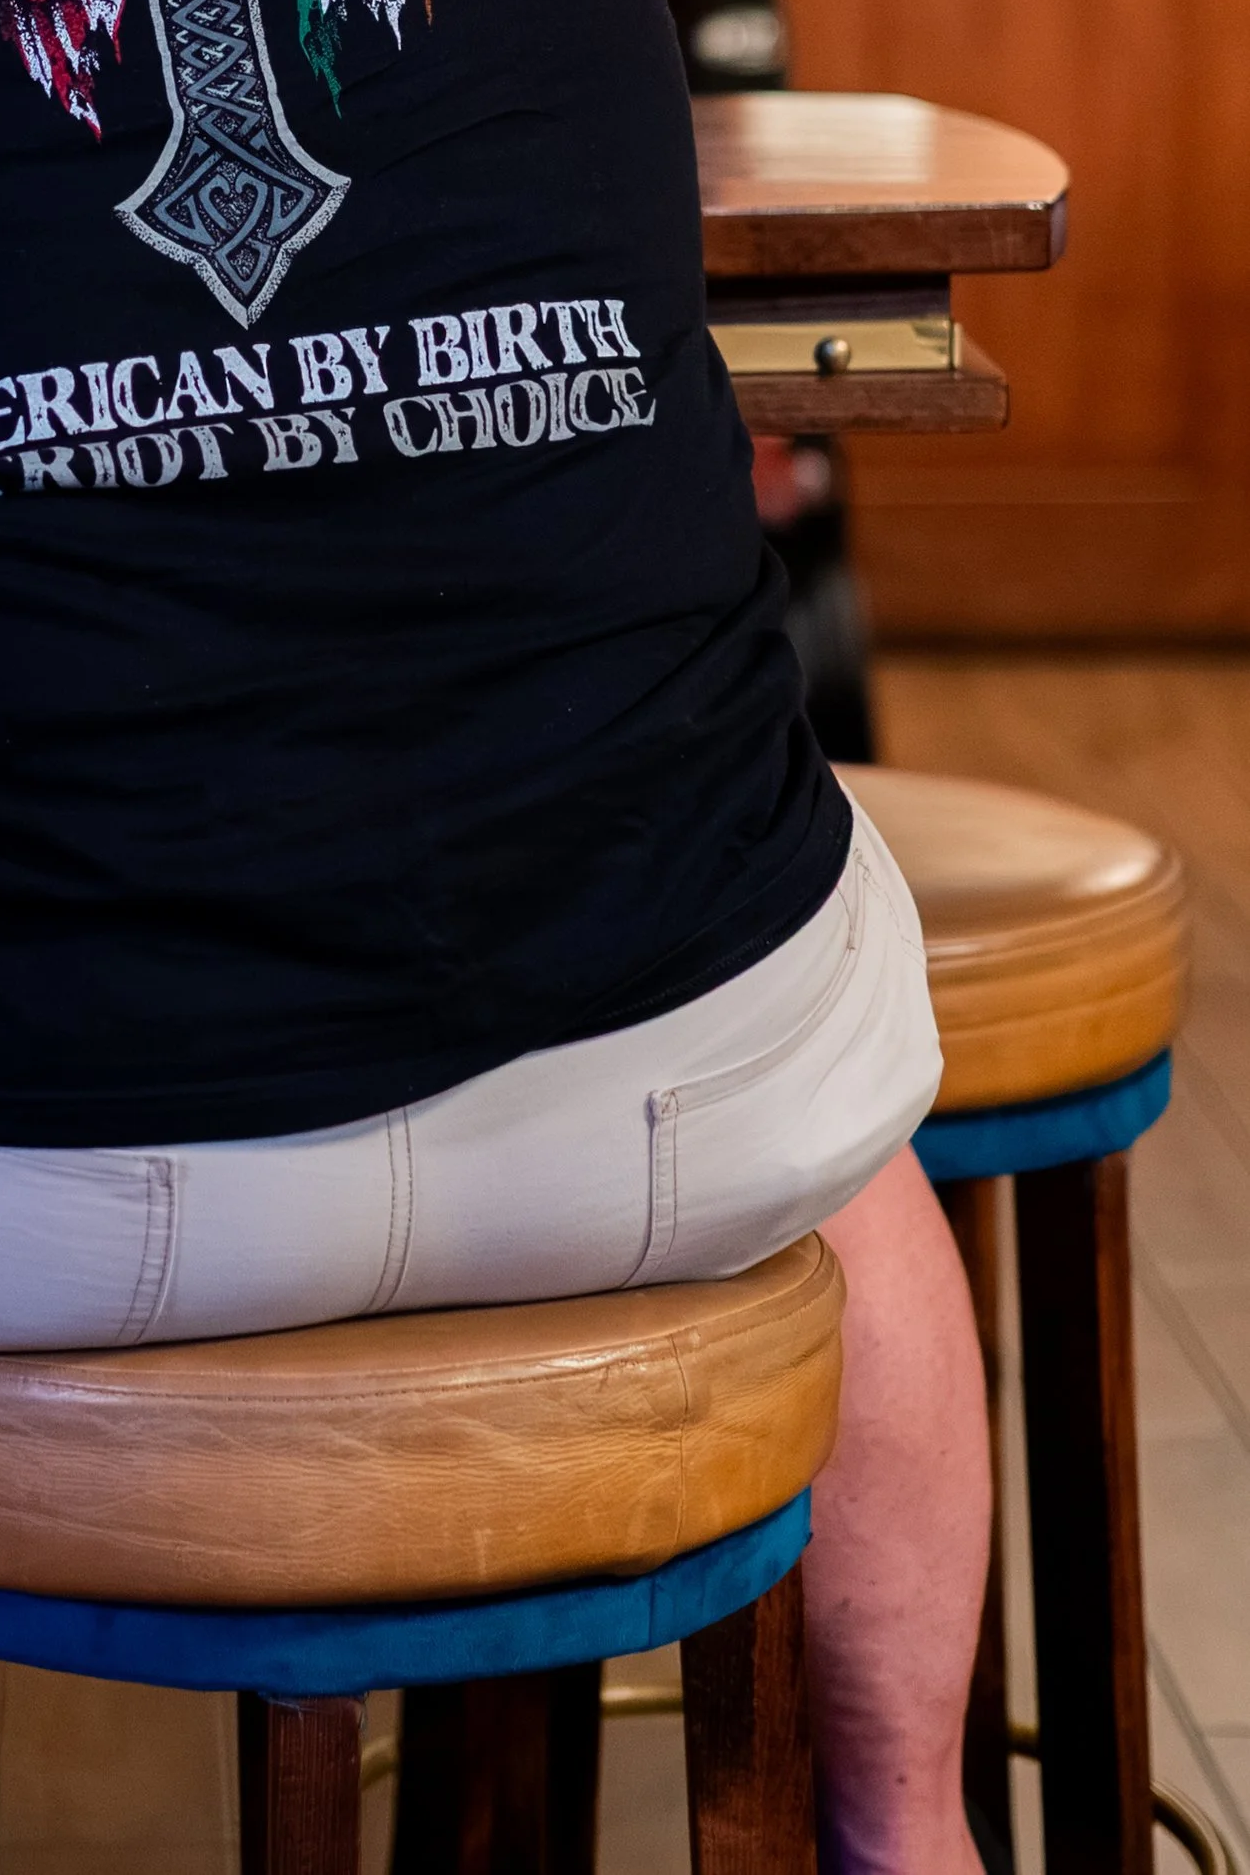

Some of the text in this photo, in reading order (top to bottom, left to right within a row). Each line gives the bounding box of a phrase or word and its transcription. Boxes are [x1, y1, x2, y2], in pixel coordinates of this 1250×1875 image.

[287, 325, 391, 405] BY
[407, 299, 642, 387] BIRTH
[247, 406, 360, 472] BY
[382, 366, 657, 459] CHOICE
